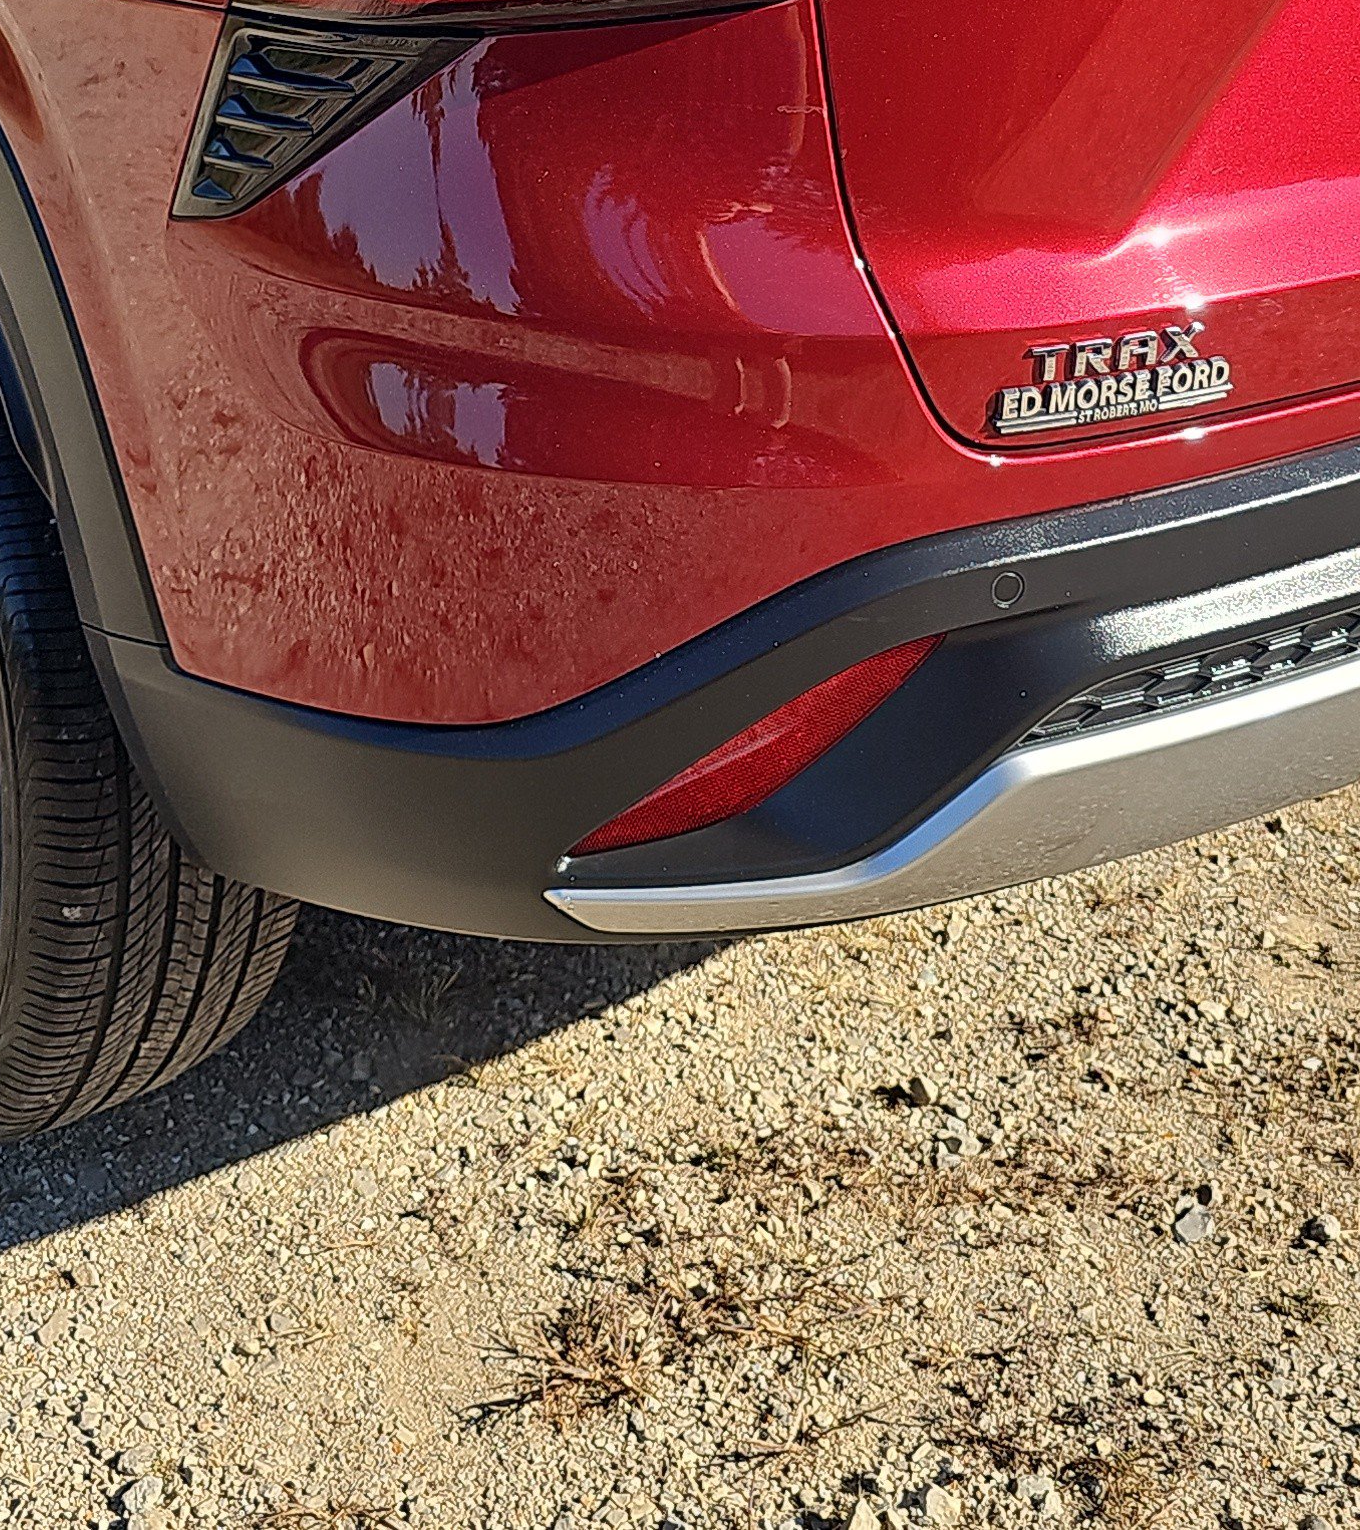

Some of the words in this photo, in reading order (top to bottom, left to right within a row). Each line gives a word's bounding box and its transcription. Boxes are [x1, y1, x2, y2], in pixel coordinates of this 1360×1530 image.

[1025, 321, 1205, 383] TRAX
[1001, 386, 1043, 420] ED
[1047, 371, 1151, 413] MORSE
[1156, 356, 1231, 396] FORD
[1139, 399, 1159, 414] MO
